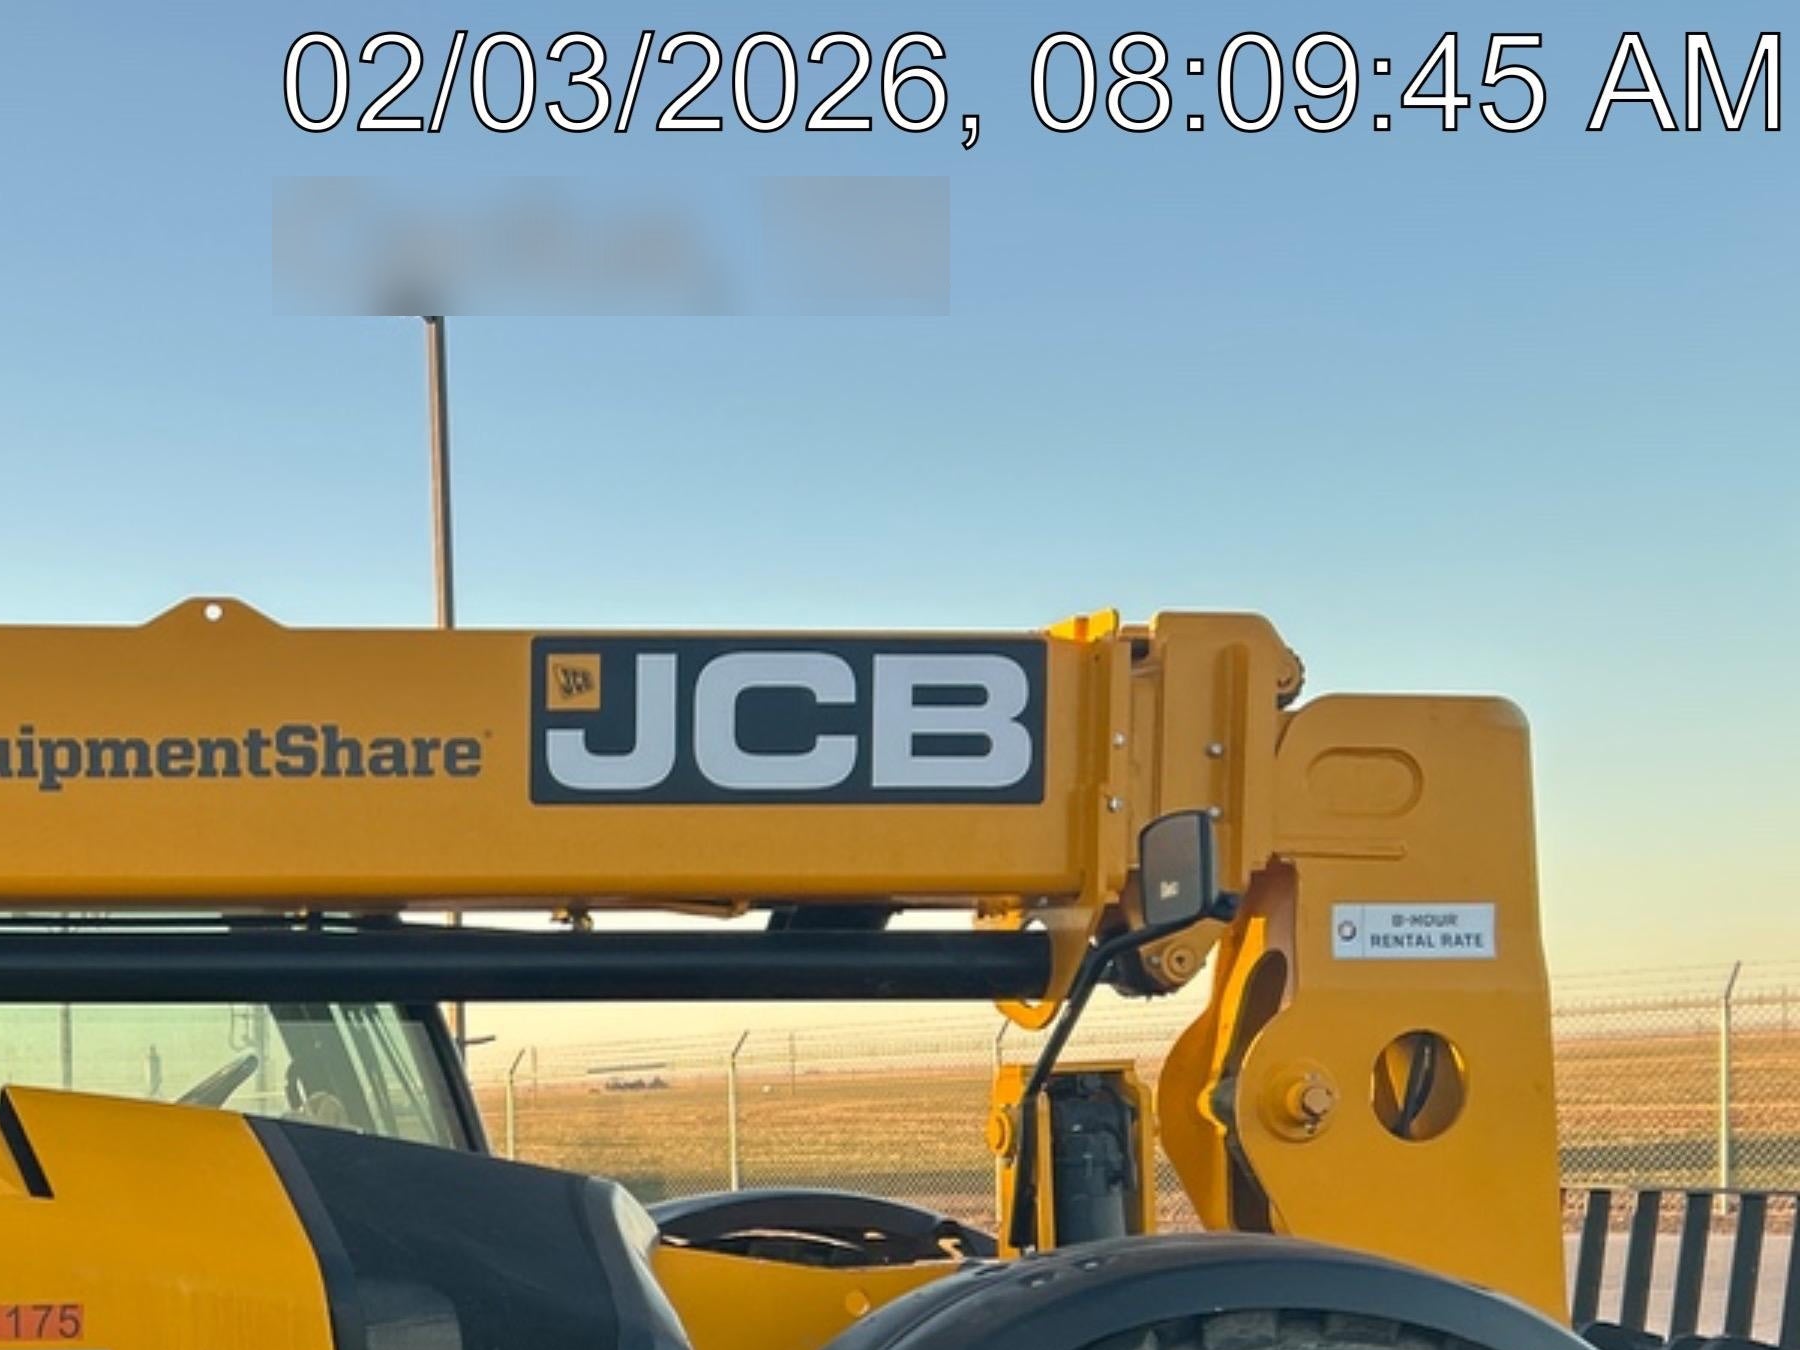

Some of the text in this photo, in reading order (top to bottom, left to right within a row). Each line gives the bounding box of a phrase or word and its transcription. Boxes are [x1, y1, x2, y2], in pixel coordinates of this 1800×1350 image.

[546, 652, 1033, 790] JCB
[1370, 933, 1484, 949] RENTAL RATE
